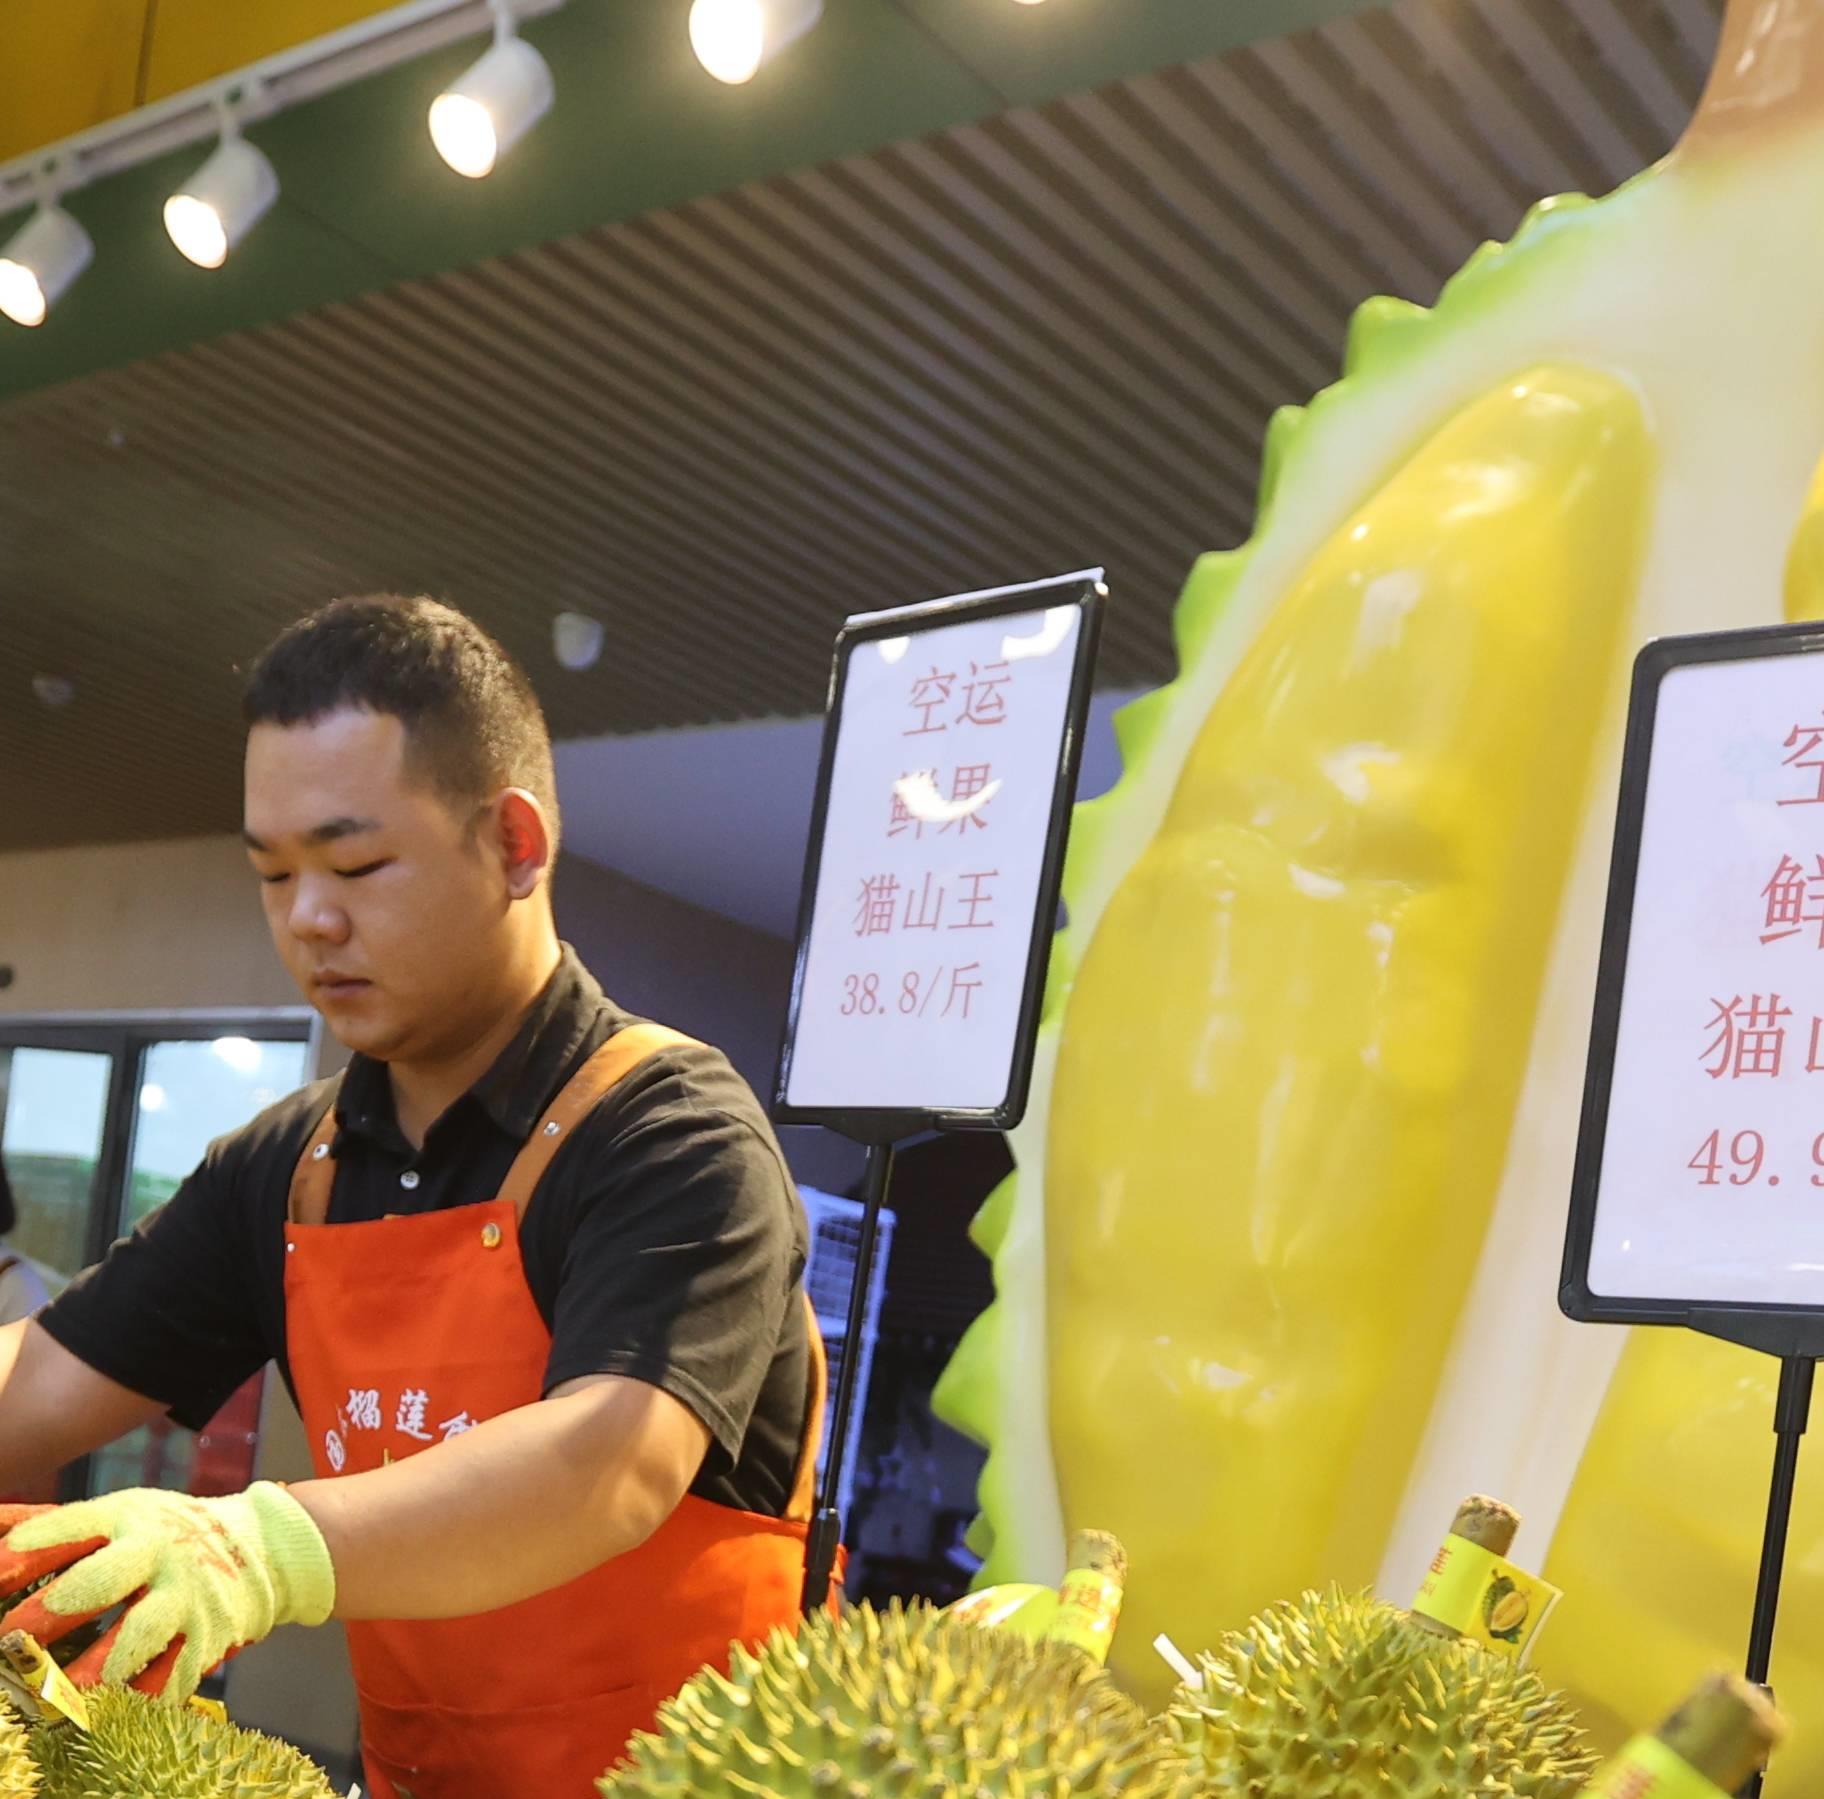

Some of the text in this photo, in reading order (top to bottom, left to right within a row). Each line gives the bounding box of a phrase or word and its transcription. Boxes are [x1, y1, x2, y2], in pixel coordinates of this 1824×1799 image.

[902, 659, 1014, 738] 空运
[851, 868, 1001, 938] 猫山王
[840, 961, 984, 1019] 38.8/斤
